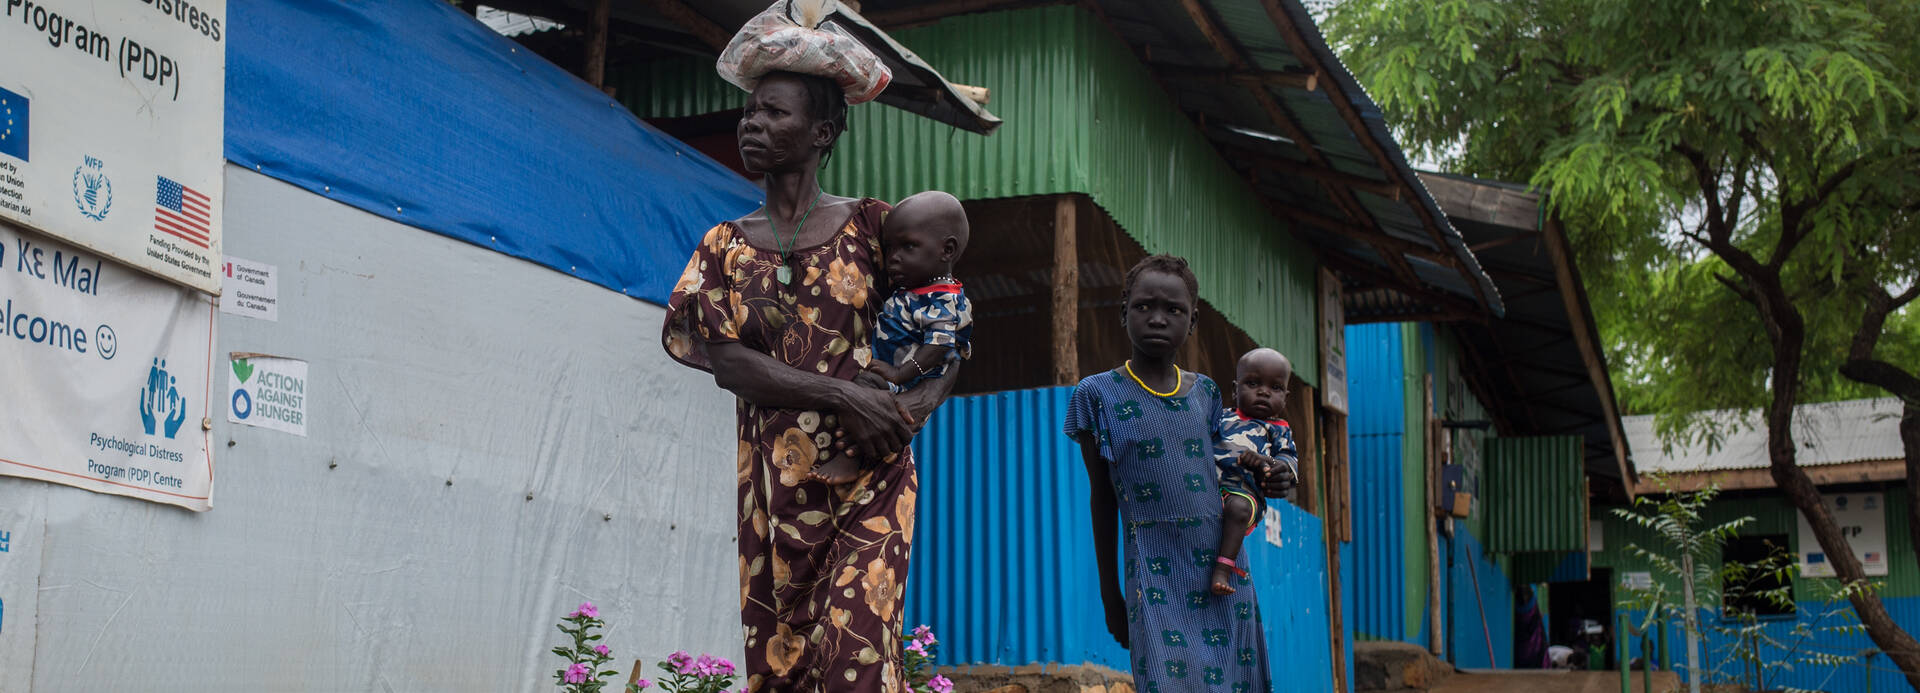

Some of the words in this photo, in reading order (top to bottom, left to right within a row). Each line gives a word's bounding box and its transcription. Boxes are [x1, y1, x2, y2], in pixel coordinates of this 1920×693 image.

[141, 0, 220, 42] stress
[119, 36, 179, 101] (PDP)
[9, 163, 17, 175] by
[84, 154, 103, 171] WFP
[6, 174, 24, 188] Union
[21, 205, 31, 216] Aid
[149, 234, 171, 252] Funding
[171, 244, 194, 259] Provided
[195, 251, 201, 262] by
[201, 254, 210, 265] the
[53, 251, 101, 296] Mal
[146, 247, 163, 261] United
[164, 254, 180, 267] States
[181, 260, 211, 278] Government
[236, 264, 269, 278] Government
[244, 274, 265, 285] Canada
[236, 290, 276, 304] Gouvernement
[246, 302, 267, 312] Canada
[256, 369, 303, 394] ACTION
[256, 387, 303, 409] AGAINST
[256, 402, 303, 425] HUNGER
[90, 432, 147, 457] Psychological
[149, 444, 183, 462] Distress
[88, 459, 126, 479] Program
[128, 467, 152, 486] (PDP)
[153, 471, 183, 488] Centre
